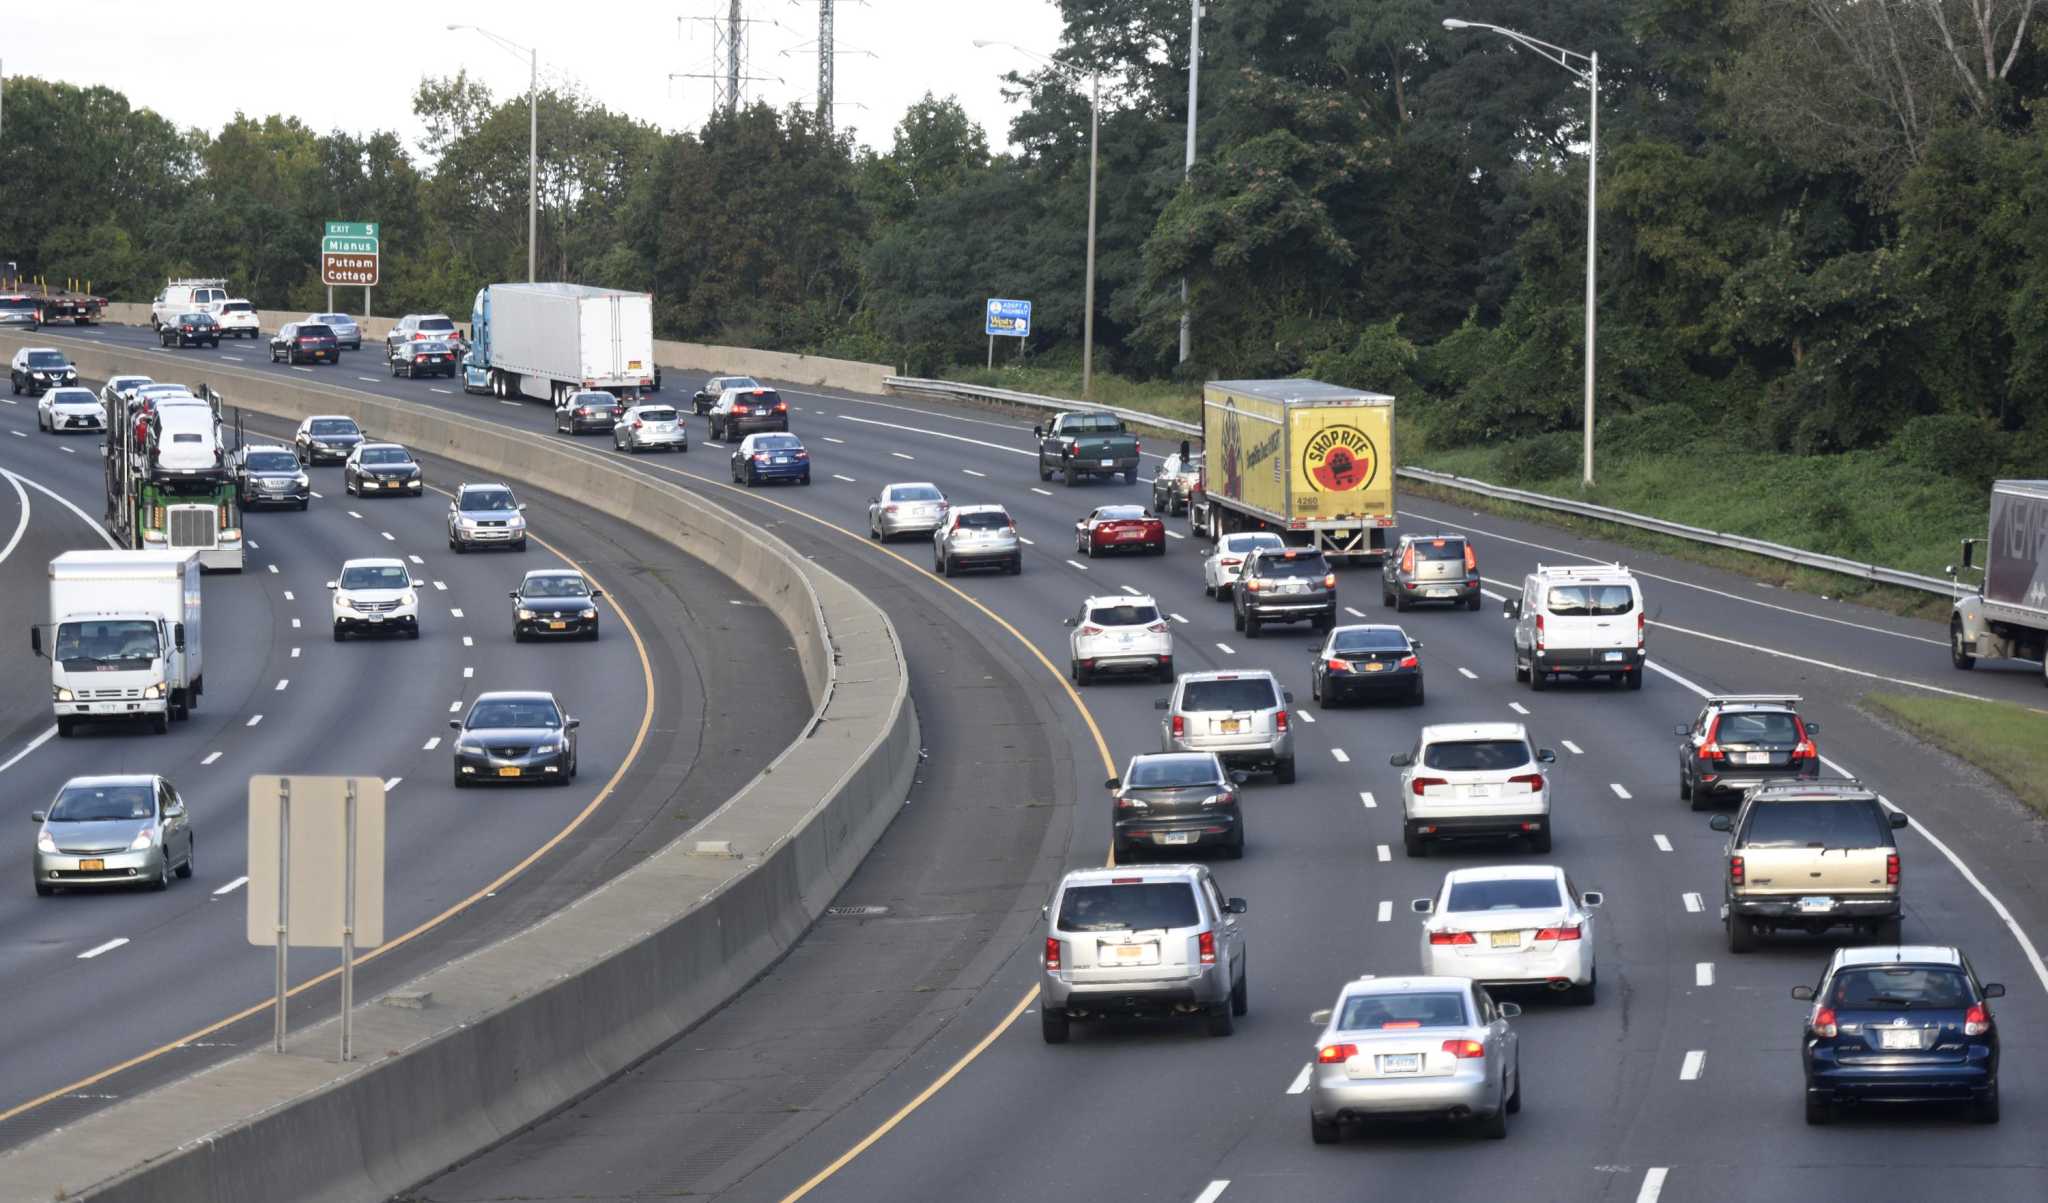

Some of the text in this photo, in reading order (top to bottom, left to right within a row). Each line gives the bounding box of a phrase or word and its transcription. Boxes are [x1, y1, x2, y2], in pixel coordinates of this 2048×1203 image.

[331, 224, 373, 235] EXIT 5
[329, 240, 371, 251] Mianus
[328, 257, 373, 268] Putnam
[328, 270, 373, 283] Cottage
